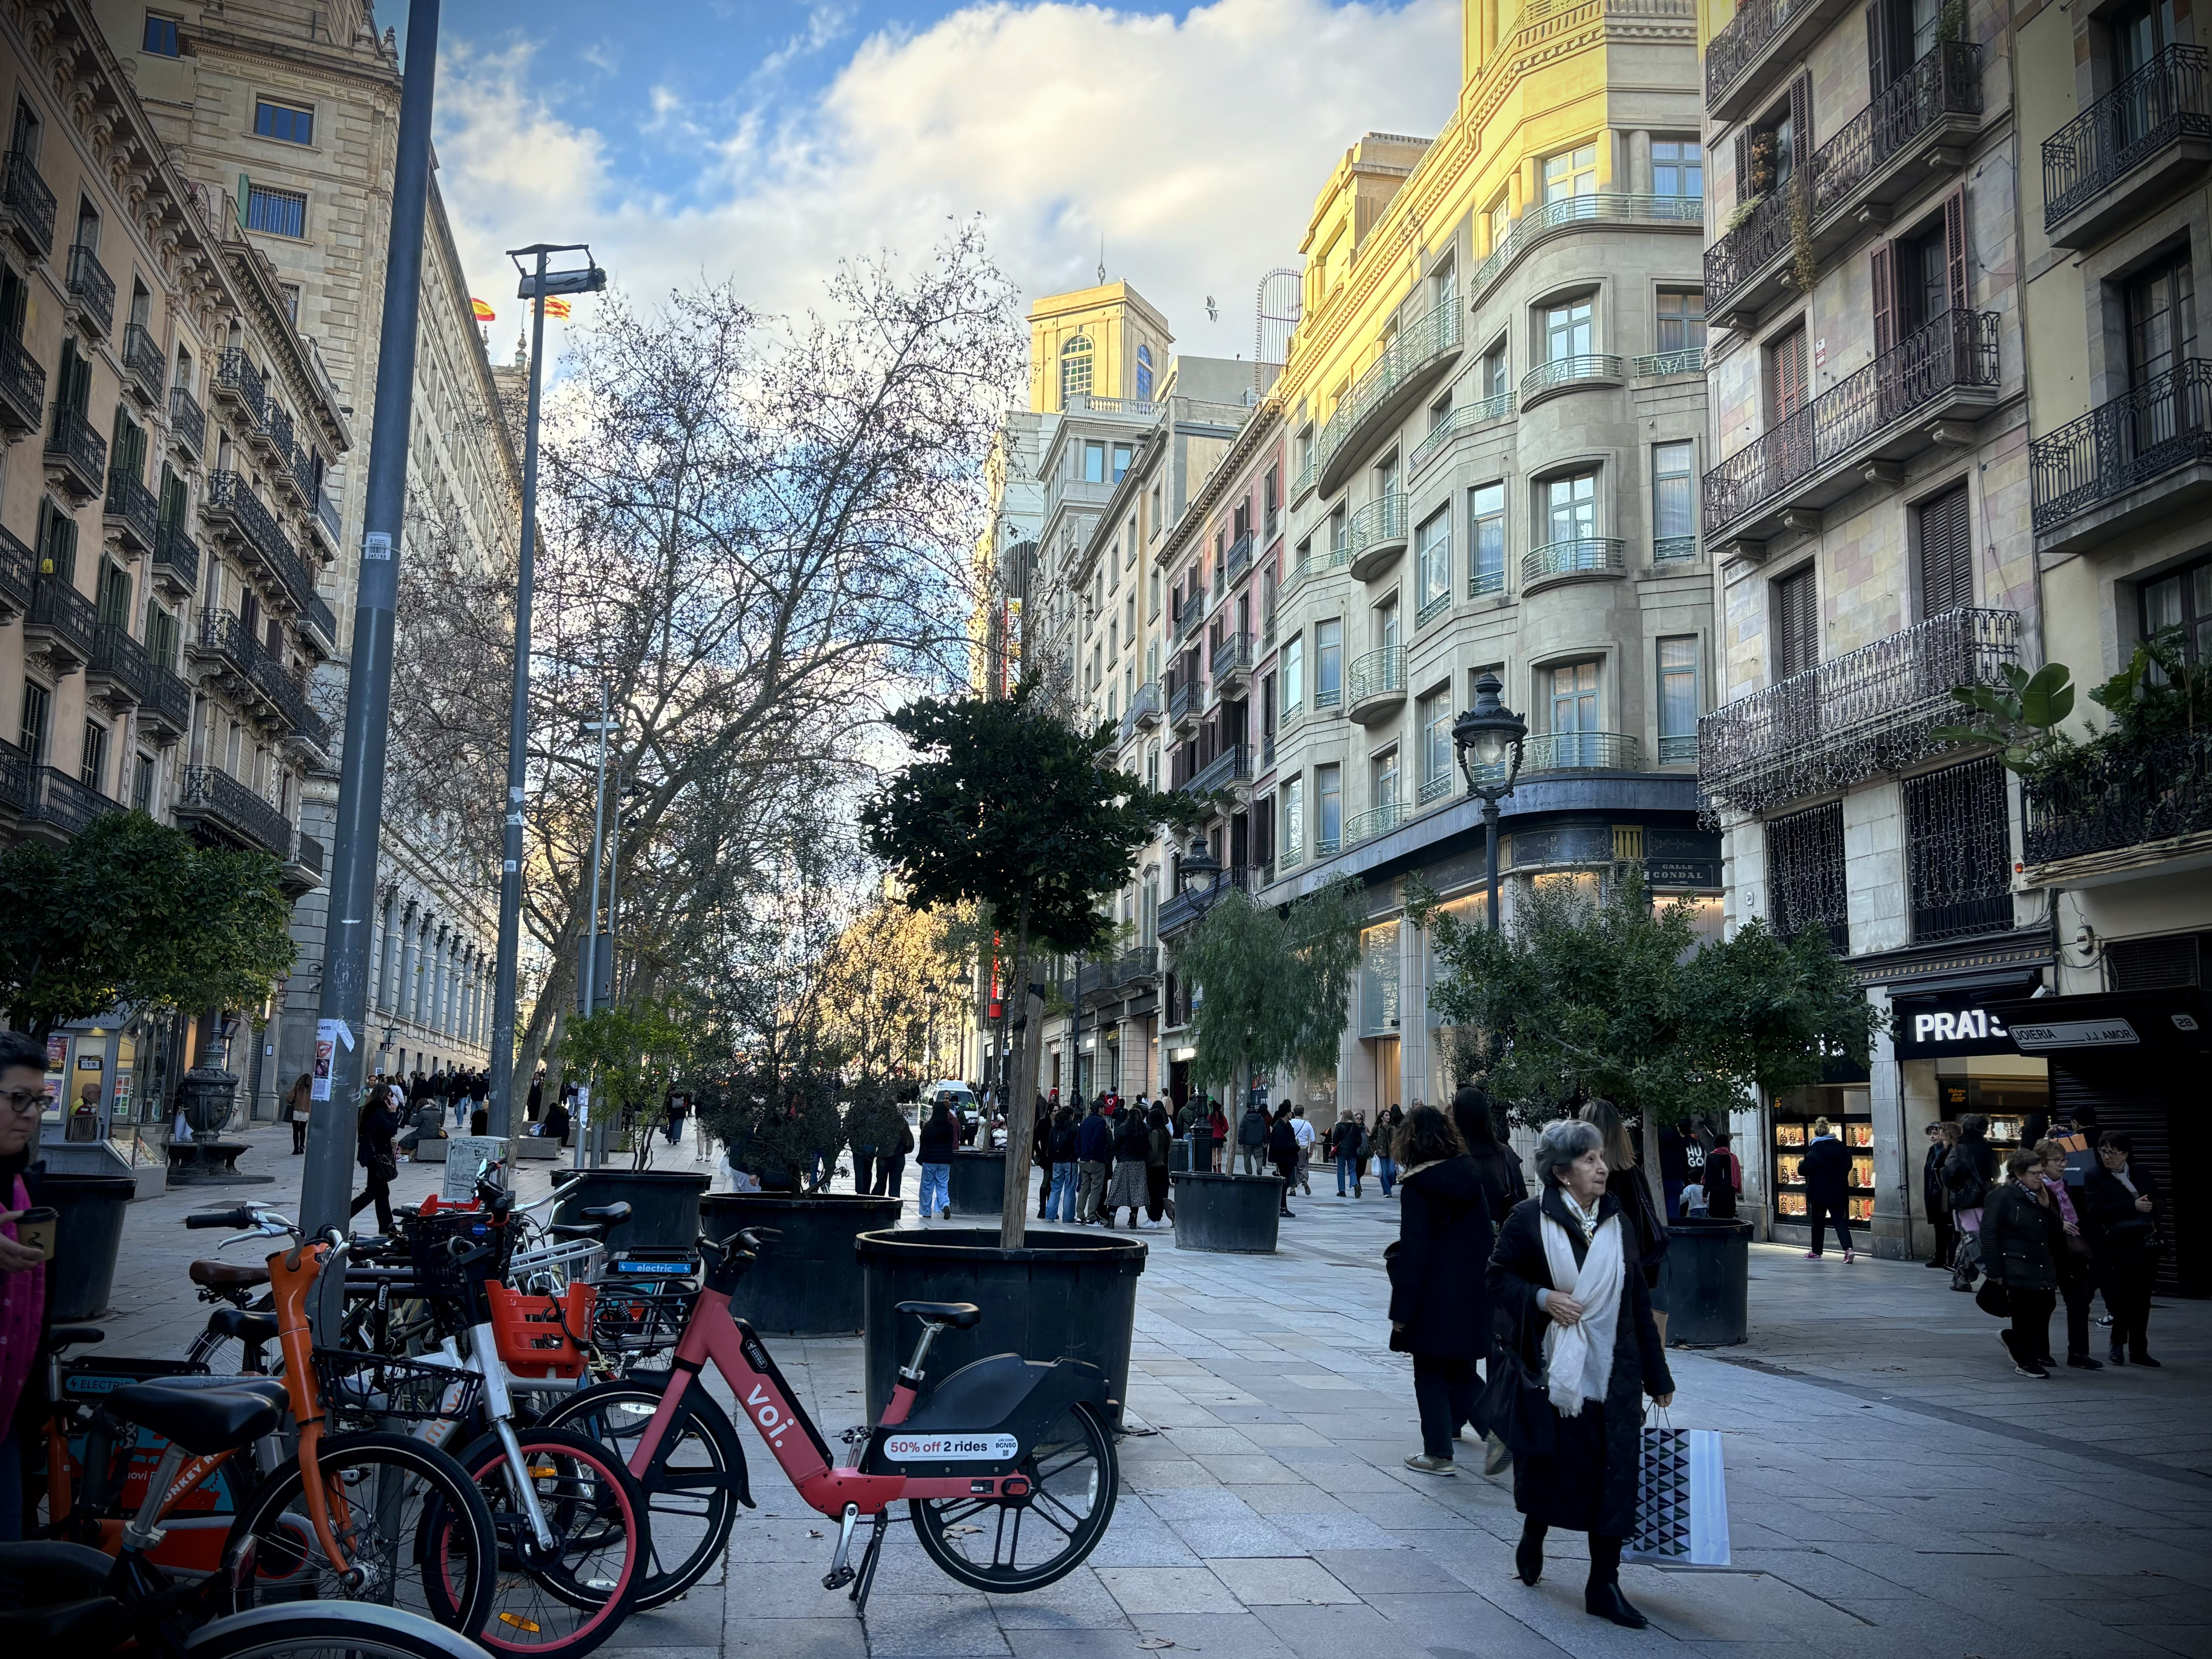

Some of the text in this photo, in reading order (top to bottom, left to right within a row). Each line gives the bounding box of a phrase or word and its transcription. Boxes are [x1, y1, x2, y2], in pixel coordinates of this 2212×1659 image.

[2176, 1018, 2193, 1027] 28
[2016, 1029, 2133, 1041] JOIERIA J.J. AMOR
[637, 1263, 672, 1272] electric
[891, 1441, 987, 1453] 50% off 2 rides
[162, 1463, 201, 1507] ONKEY
